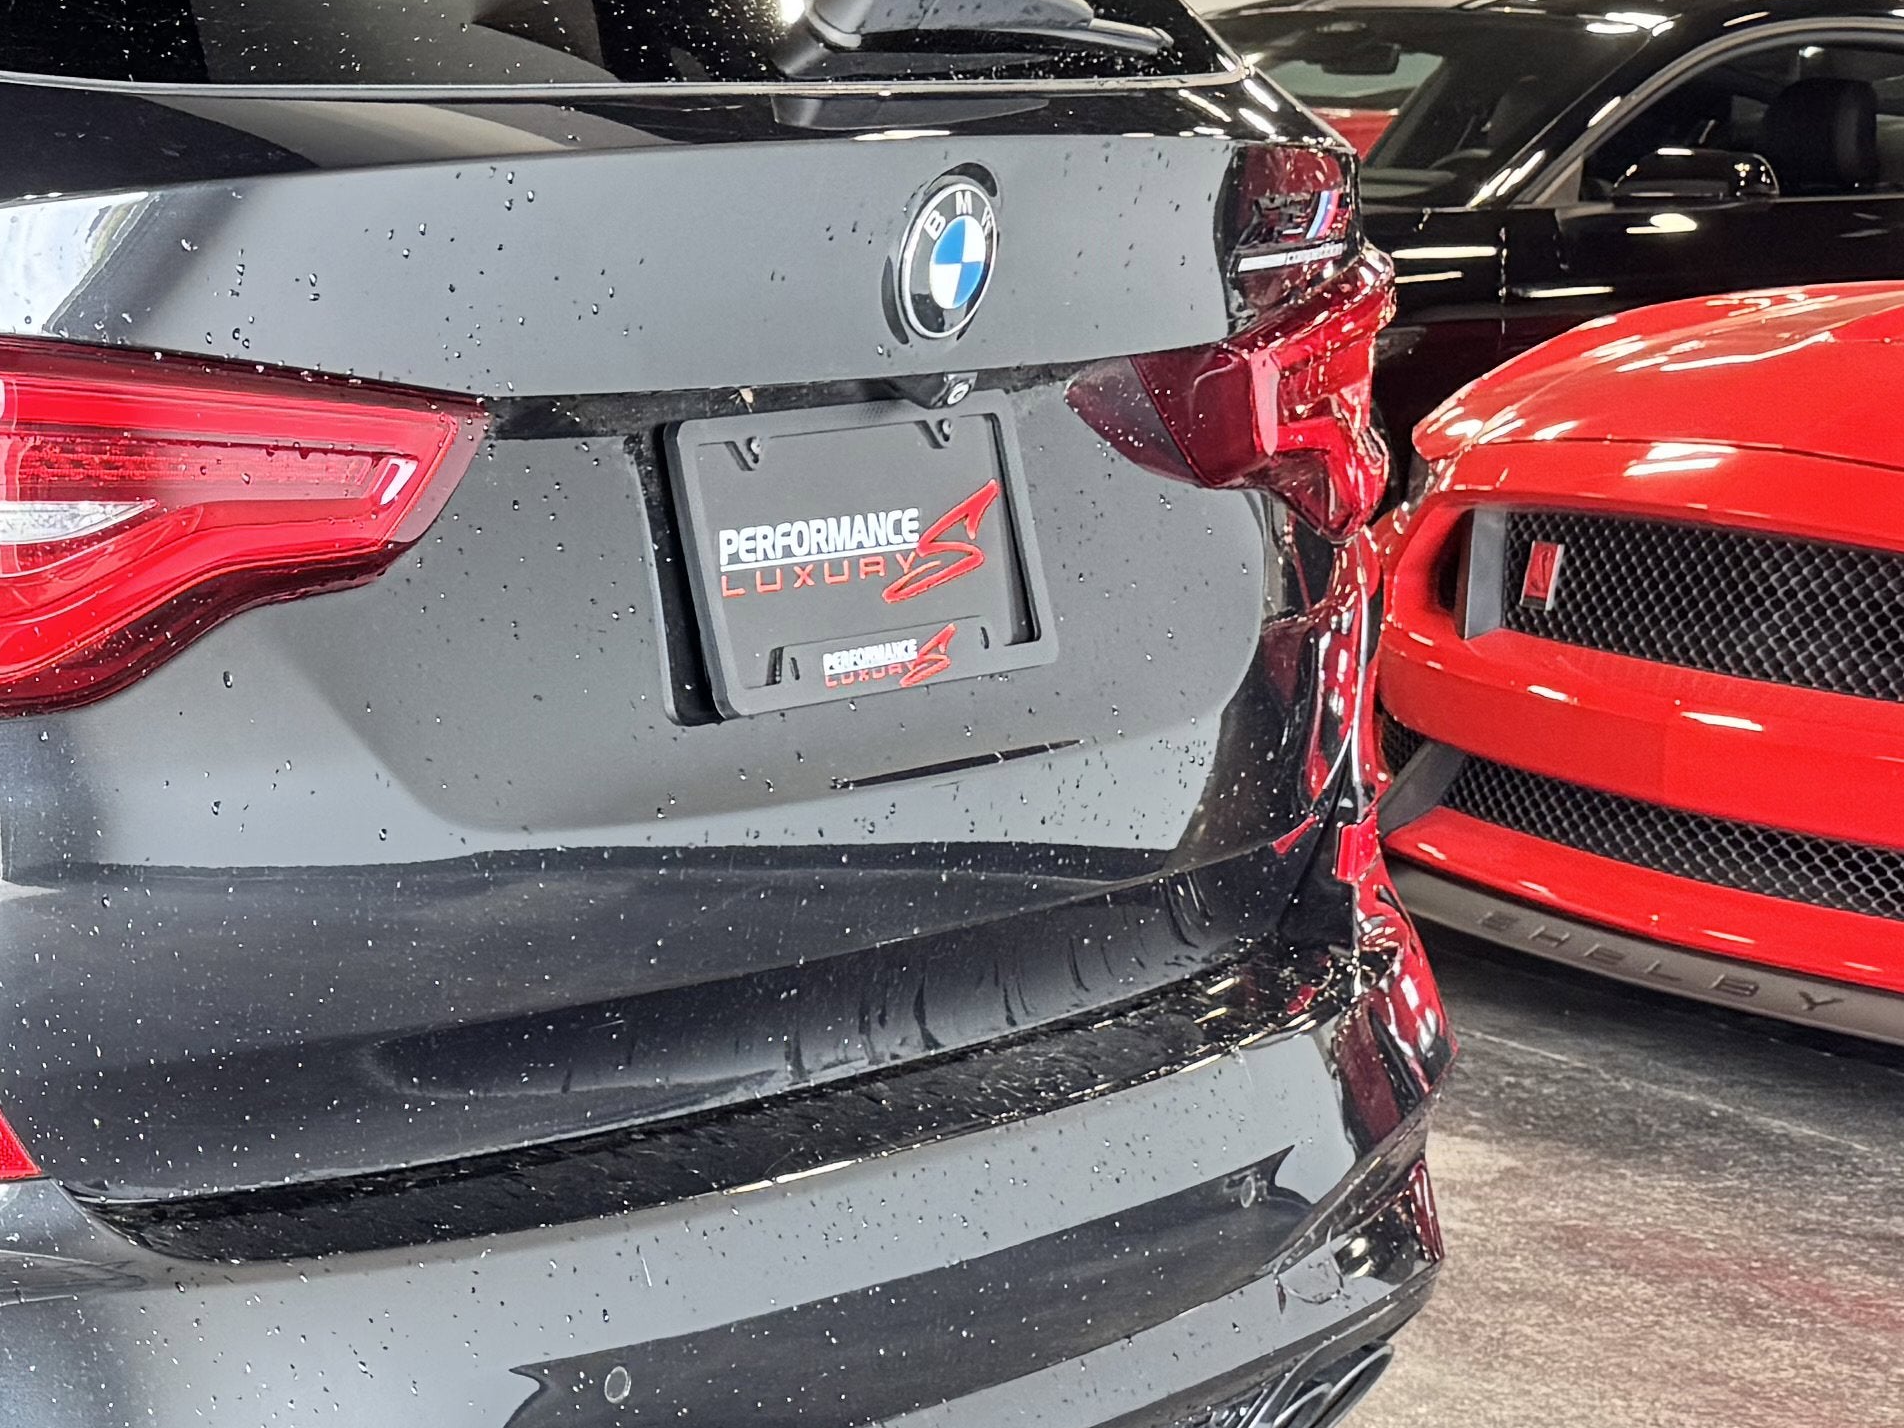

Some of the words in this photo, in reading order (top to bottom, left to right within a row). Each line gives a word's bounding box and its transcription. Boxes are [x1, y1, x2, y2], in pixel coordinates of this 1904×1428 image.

[923, 190, 995, 241] BMW
[718, 507, 921, 568] PERFORMANCE
[720, 551, 917, 598] LUXURY
[823, 638, 918, 674] PERFORMANCE
[1477, 909, 1843, 1012] SHELBY
